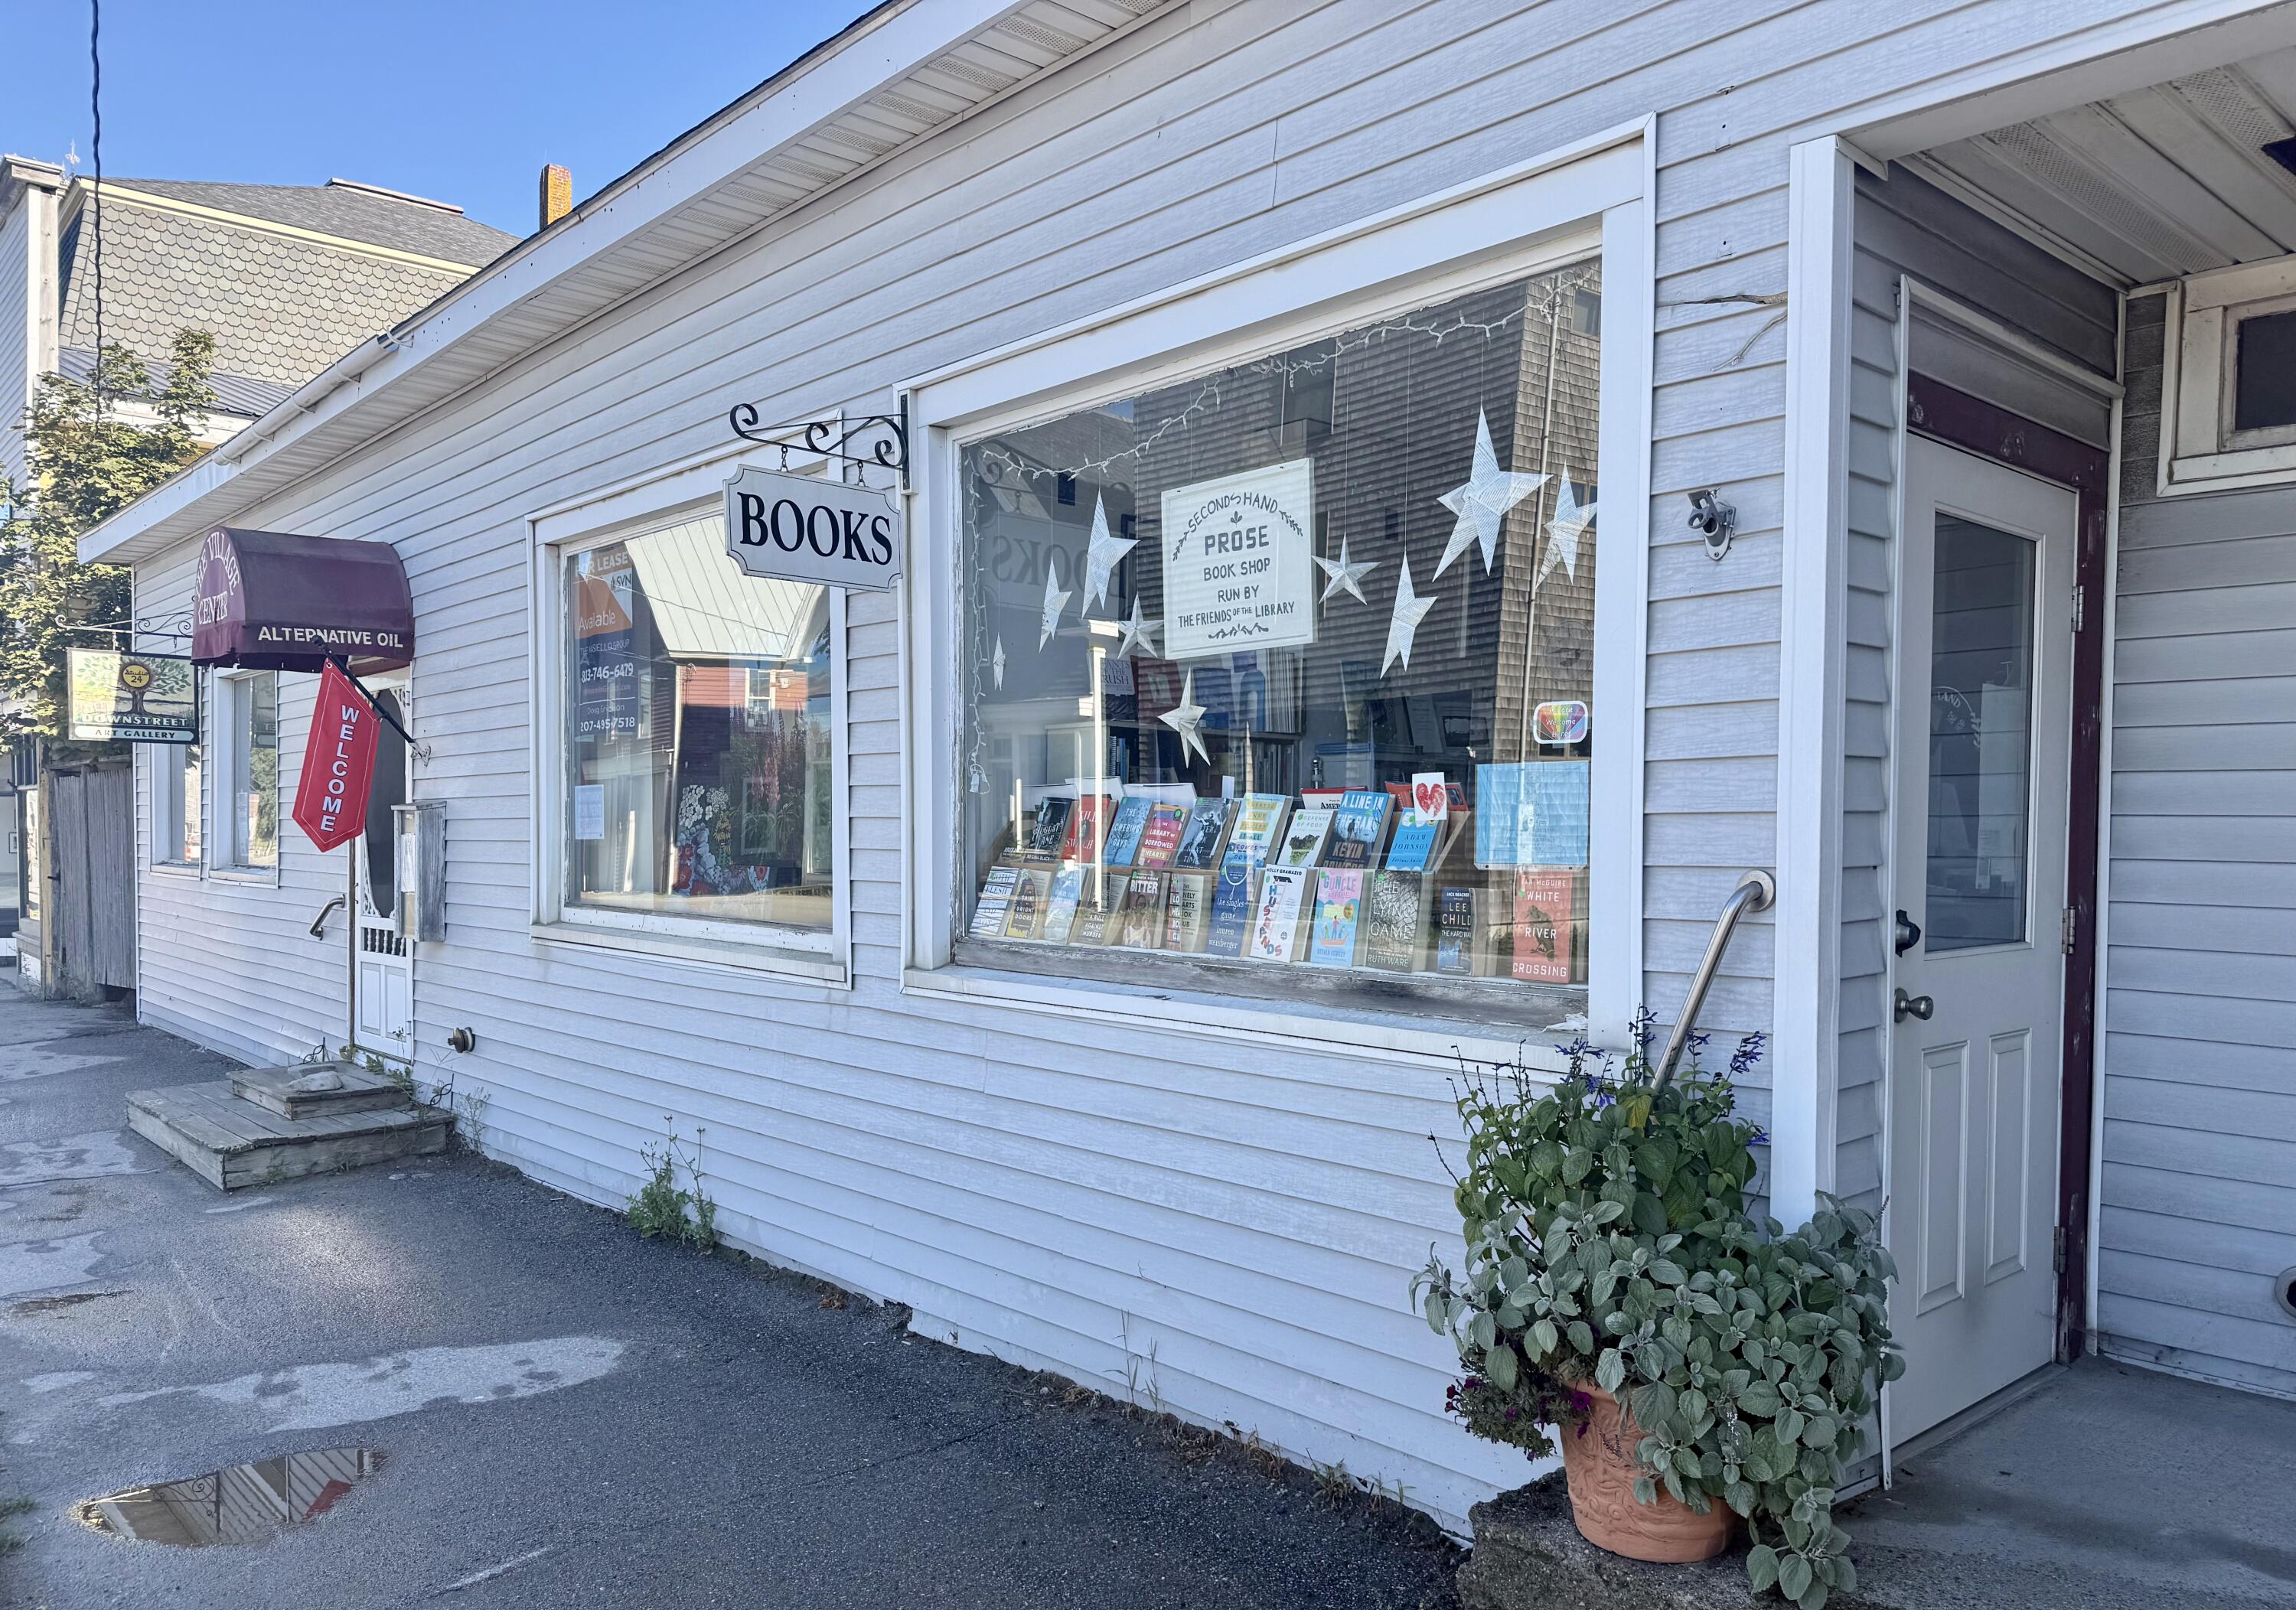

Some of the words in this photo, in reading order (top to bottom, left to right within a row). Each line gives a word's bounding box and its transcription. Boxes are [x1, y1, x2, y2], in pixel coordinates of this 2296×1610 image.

[1188, 494, 1231, 533] SECOND
[1243, 492, 1278, 513] HAND
[737, 492, 892, 565] BOOKS
[1205, 525, 1270, 556] PROSE
[195, 549, 207, 602] THE
[207, 531, 240, 596] VILLAGE
[598, 552, 628, 572] LEASE
[1204, 563, 1236, 582] BOOK
[1241, 557, 1270, 575] SHOP
[617, 574, 631, 587] SVN
[1218, 588, 1241, 603] RUN
[1244, 585, 1260, 599] BY
[197, 591, 228, 625] CENTER
[1178, 615, 1195, 628] THE
[1195, 609, 1231, 626] FRIENDS
[1255, 601, 1295, 618] LIBRARY
[579, 609, 616, 631] Available
[258, 626, 372, 646] ALTERNATIVE
[377, 633, 403, 648] OIL
[83, 715, 188, 727] DOWNSTREET
[124, 730, 175, 738] GALLERY
[320, 704, 360, 833] WELCOME
[1342, 794, 1349, 808] A
[1349, 795, 1372, 810] LINE
[1373, 797, 1384, 810] IN
[1125, 808, 1137, 816] THE
[1336, 813, 1353, 827] THE
[1114, 823, 1141, 833] OWERING
[1150, 829, 1170, 837] LIBRARY
[1065, 838, 1094, 849] SWCH
[1112, 839, 1128, 849] DAYS
[1145, 839, 1173, 849] BORROWED
[1187, 845, 1203, 853] NXT
[1332, 842, 1365, 859] KEVIN
[1145, 850, 1166, 859] HEARTS
[1130, 880, 1159, 895] BITTER
[1324, 875, 1356, 892] GUNCLE
[1375, 881, 1401, 893] THE
[1527, 891, 1560, 902] WHITE
[1226, 899, 1244, 911] singles
[1372, 898, 1412, 918] LYING
[1450, 902, 1467, 912] LEE
[1220, 911, 1236, 921] game
[1259, 885, 1283, 957] HUSBANDS
[1442, 914, 1472, 926] CHILD
[1216, 925, 1234, 936] lauren
[1370, 922, 1412, 940] GAME
[1525, 927, 1557, 940] RIVER
[1209, 937, 1238, 951] weisberger
[1368, 954, 1386, 963] RUTH
[1388, 957, 1408, 967] WARE
[1512, 963, 1567, 977] CROSSING
